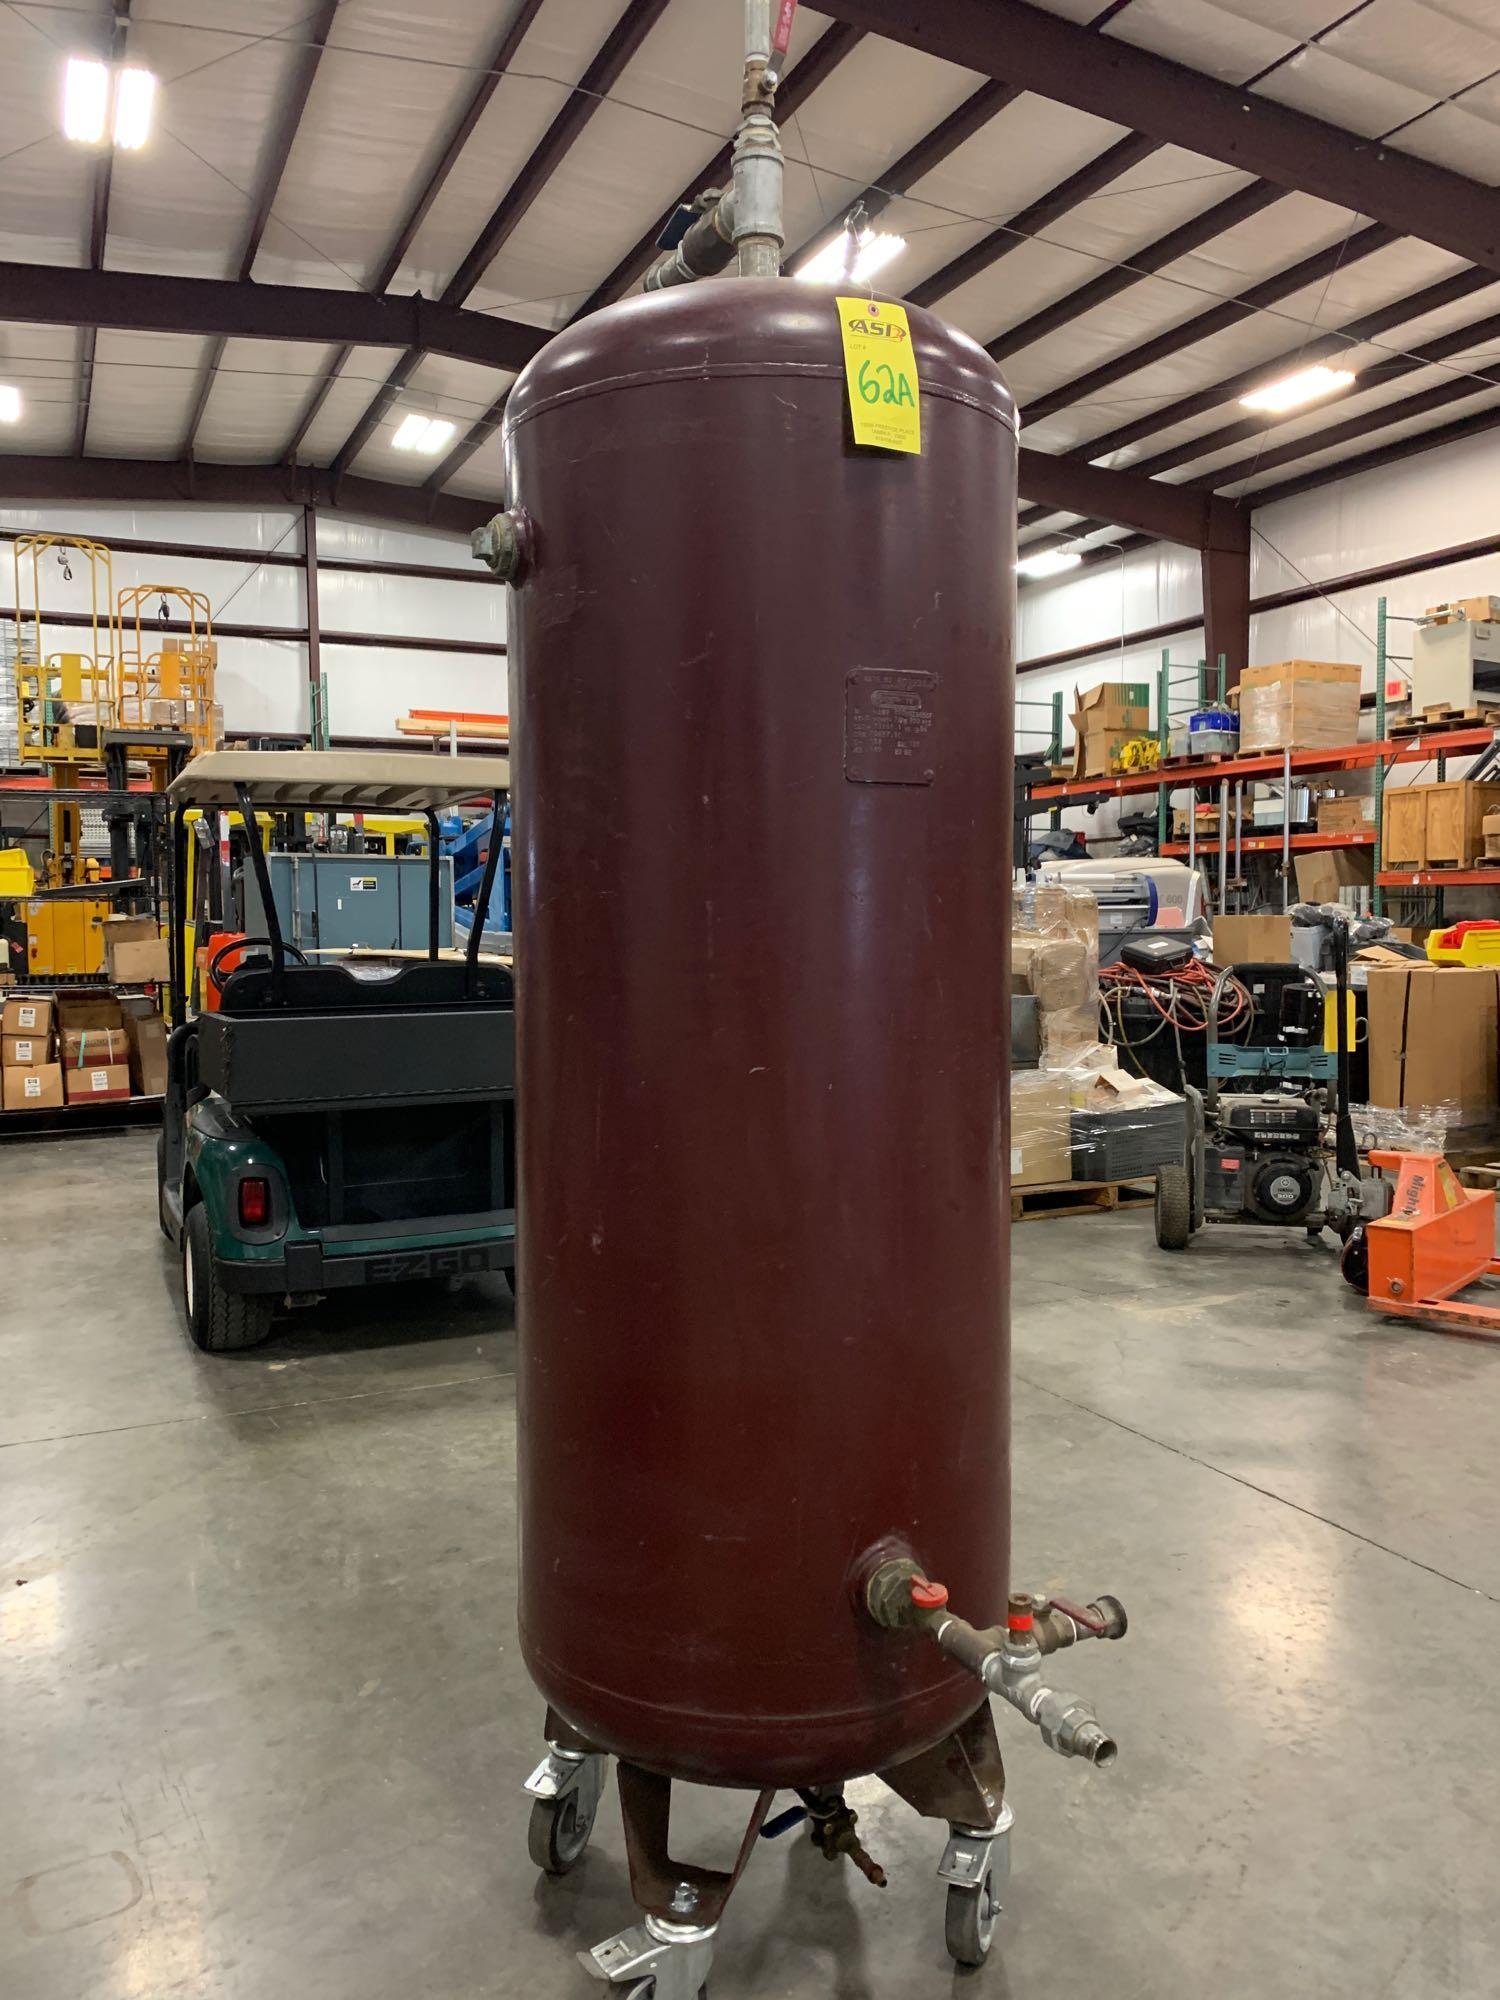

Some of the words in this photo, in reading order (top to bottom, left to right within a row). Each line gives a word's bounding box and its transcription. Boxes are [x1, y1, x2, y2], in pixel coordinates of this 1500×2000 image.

[849, 343, 862, 351] LOT
[859, 360, 915, 408] 62A
[1166, 894, 1183, 904] 600
[1403, 1175, 1425, 1215] Mighty
